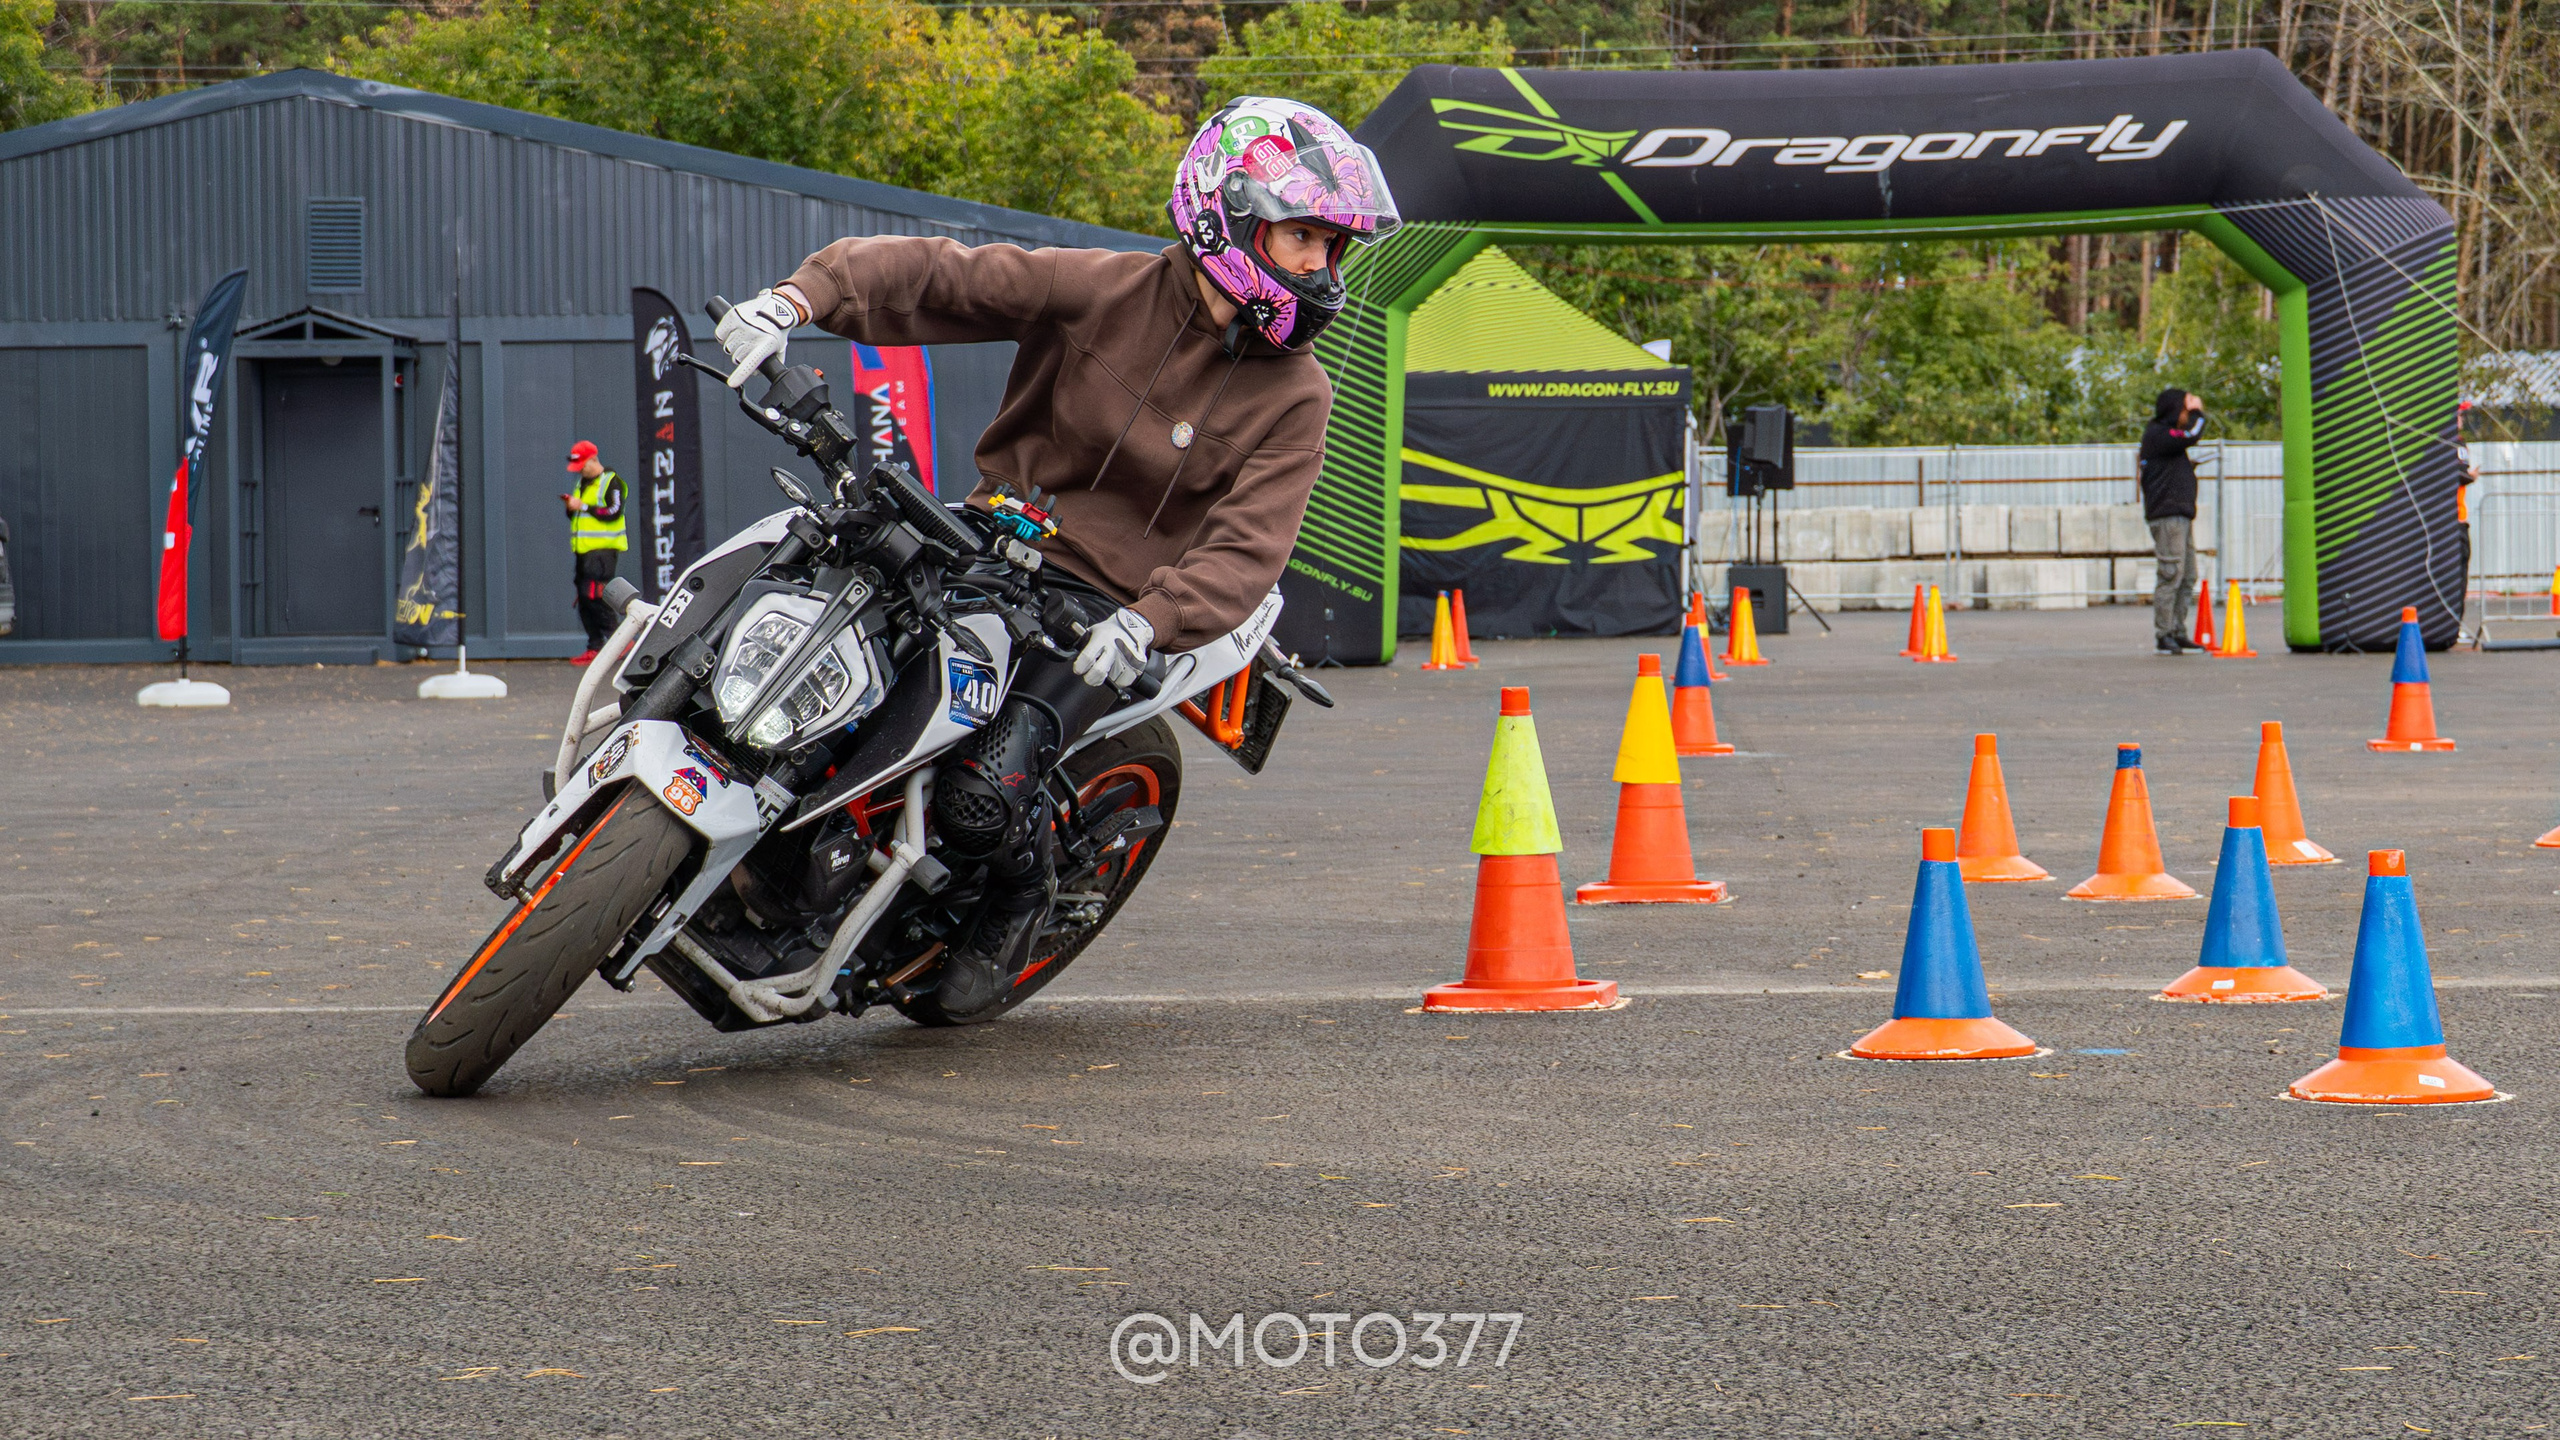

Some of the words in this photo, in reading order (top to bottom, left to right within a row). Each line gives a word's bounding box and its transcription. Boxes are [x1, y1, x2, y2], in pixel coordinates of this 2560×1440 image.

[1622, 114, 2188, 173] Dragonfly
[1198, 220, 1215, 244] 42
[1487, 380, 1680, 398] WWW.DRAGON-FLY.SU
[895, 380, 908, 442] TEAM
[653, 390, 676, 604] ARTIZAN
[1286, 558, 1375, 602] GONFLY.SU
[963, 679, 996, 714] 40
[668, 786, 694, 811] 96
